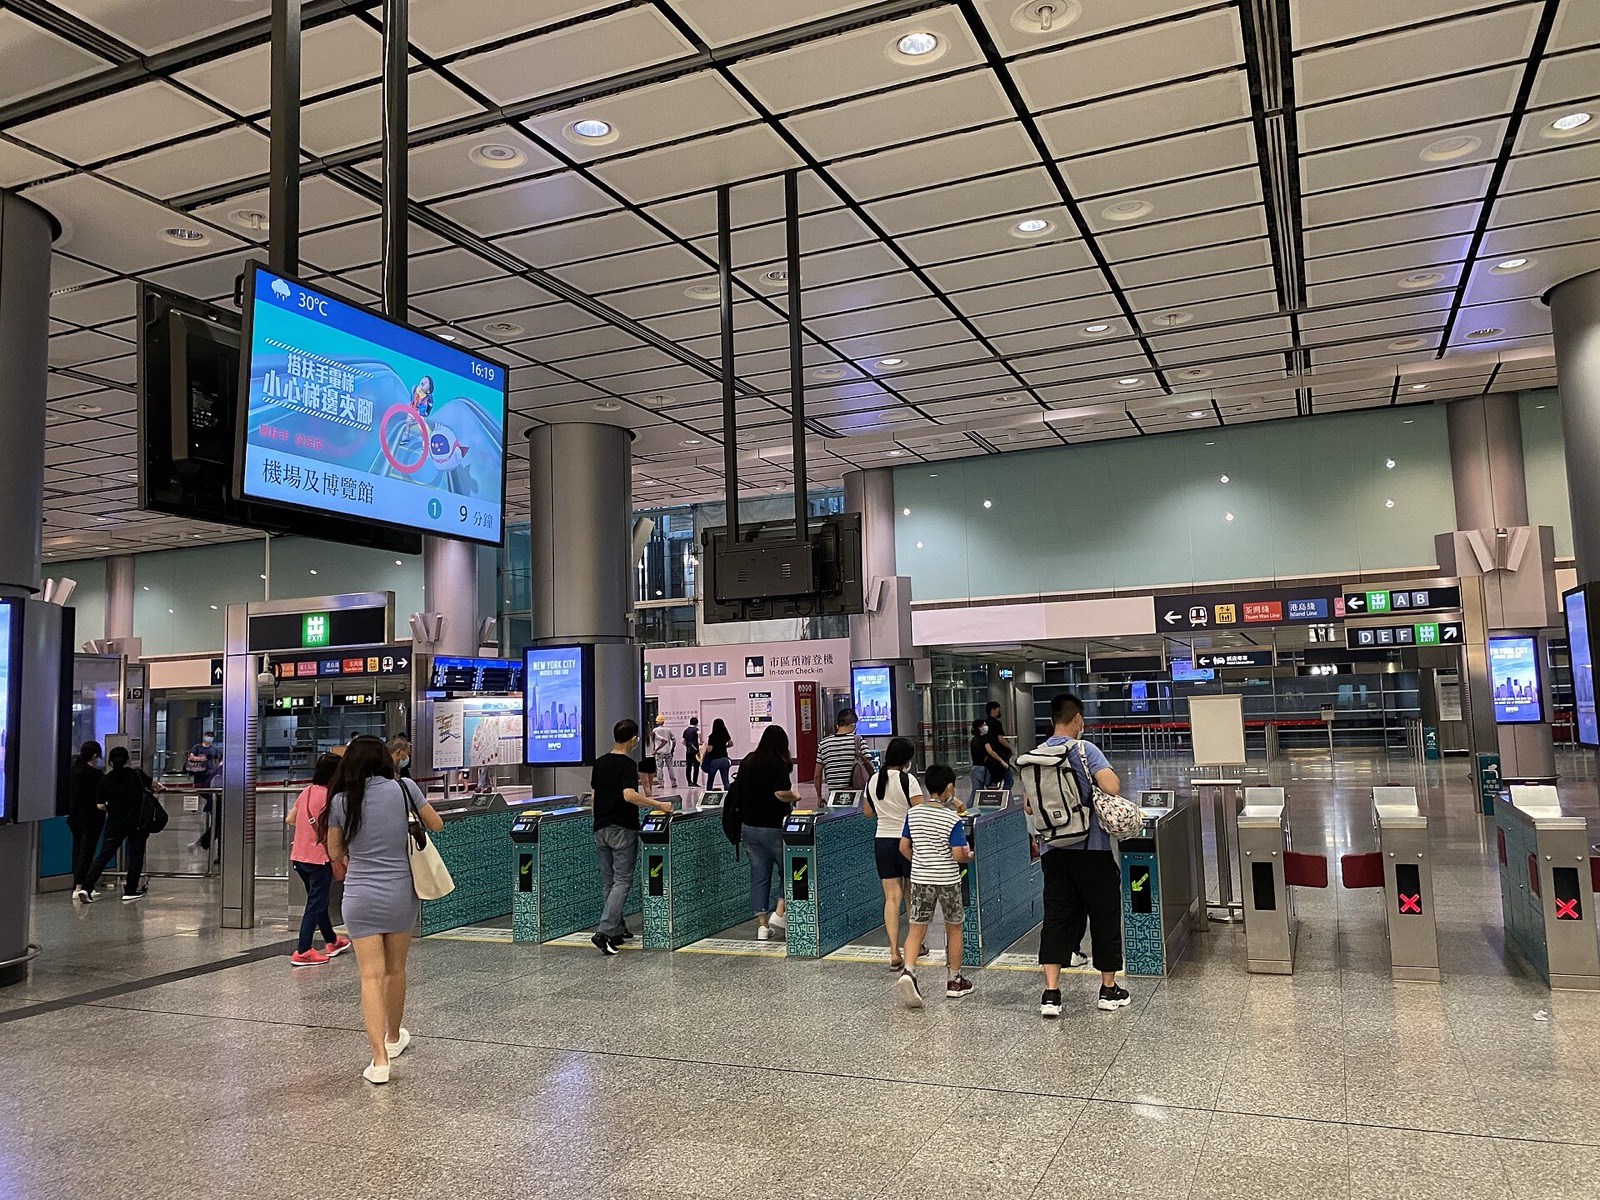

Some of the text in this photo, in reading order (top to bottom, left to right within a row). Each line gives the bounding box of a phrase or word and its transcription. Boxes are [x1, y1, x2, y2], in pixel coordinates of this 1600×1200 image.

[298, 292, 328, 317] 30°C
[287, 353, 355, 393] 搭扶手電梯
[470, 361, 495, 381] 16:19
[262, 369, 374, 426] 小心梯邊夾腳
[262, 458, 374, 504] 機場及博覽館
[459, 504, 494, 530] 9 分鐘
[1397, 594, 1425, 606] A B
[1361, 630, 1408, 643] D E F
[533, 659, 576, 670] NEW YORK CITY
[656, 668, 664, 677] A
[672, 666, 678, 676] B
[686, 665, 694, 676] D
[702, 664, 708, 675] E
[717, 664, 724, 674] F
[769, 667, 824, 676] In-town Check-in
